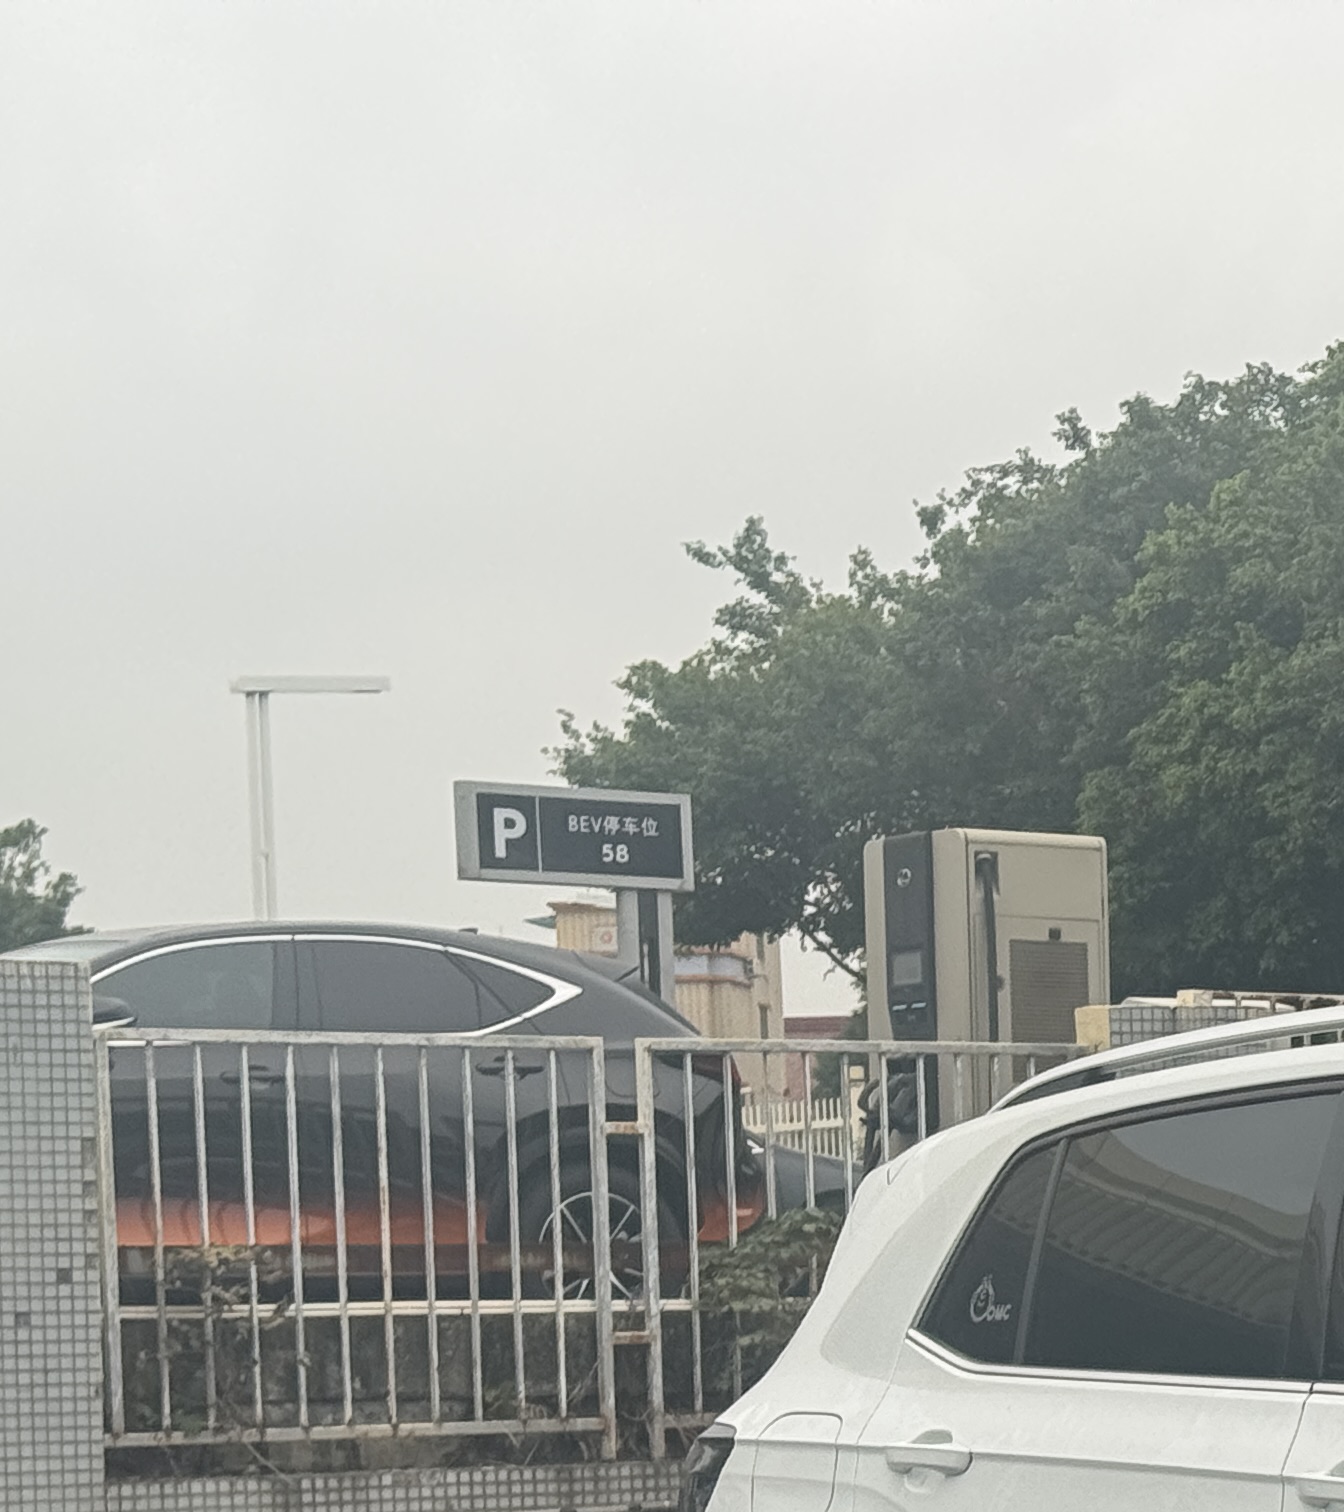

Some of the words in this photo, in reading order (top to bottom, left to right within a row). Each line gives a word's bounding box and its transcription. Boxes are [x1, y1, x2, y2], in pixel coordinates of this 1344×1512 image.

[493, 807, 527, 859] P
[567, 814, 660, 837] BEV停车位
[601, 843, 630, 864] 58
